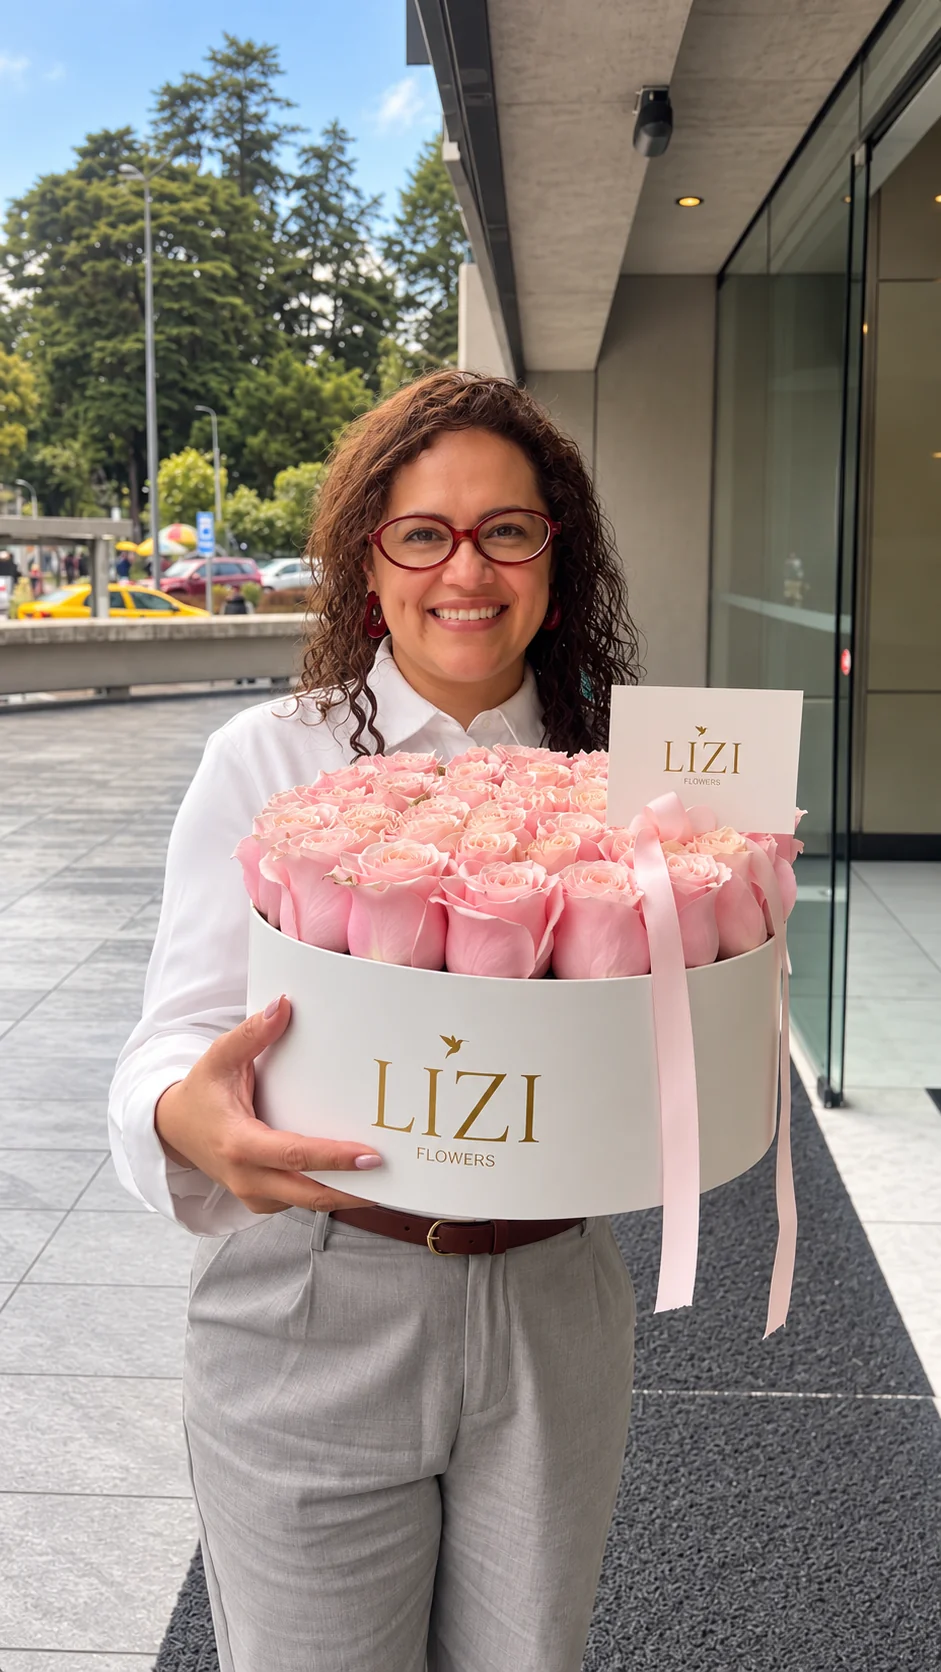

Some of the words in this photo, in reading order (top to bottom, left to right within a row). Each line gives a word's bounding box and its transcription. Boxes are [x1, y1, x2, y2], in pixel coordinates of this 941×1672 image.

[663, 741, 742, 774] LIZI
[683, 777, 721, 786] FLOWERS
[371, 1058, 542, 1143] LIZI
[416, 1146, 495, 1167] FLOWERS
